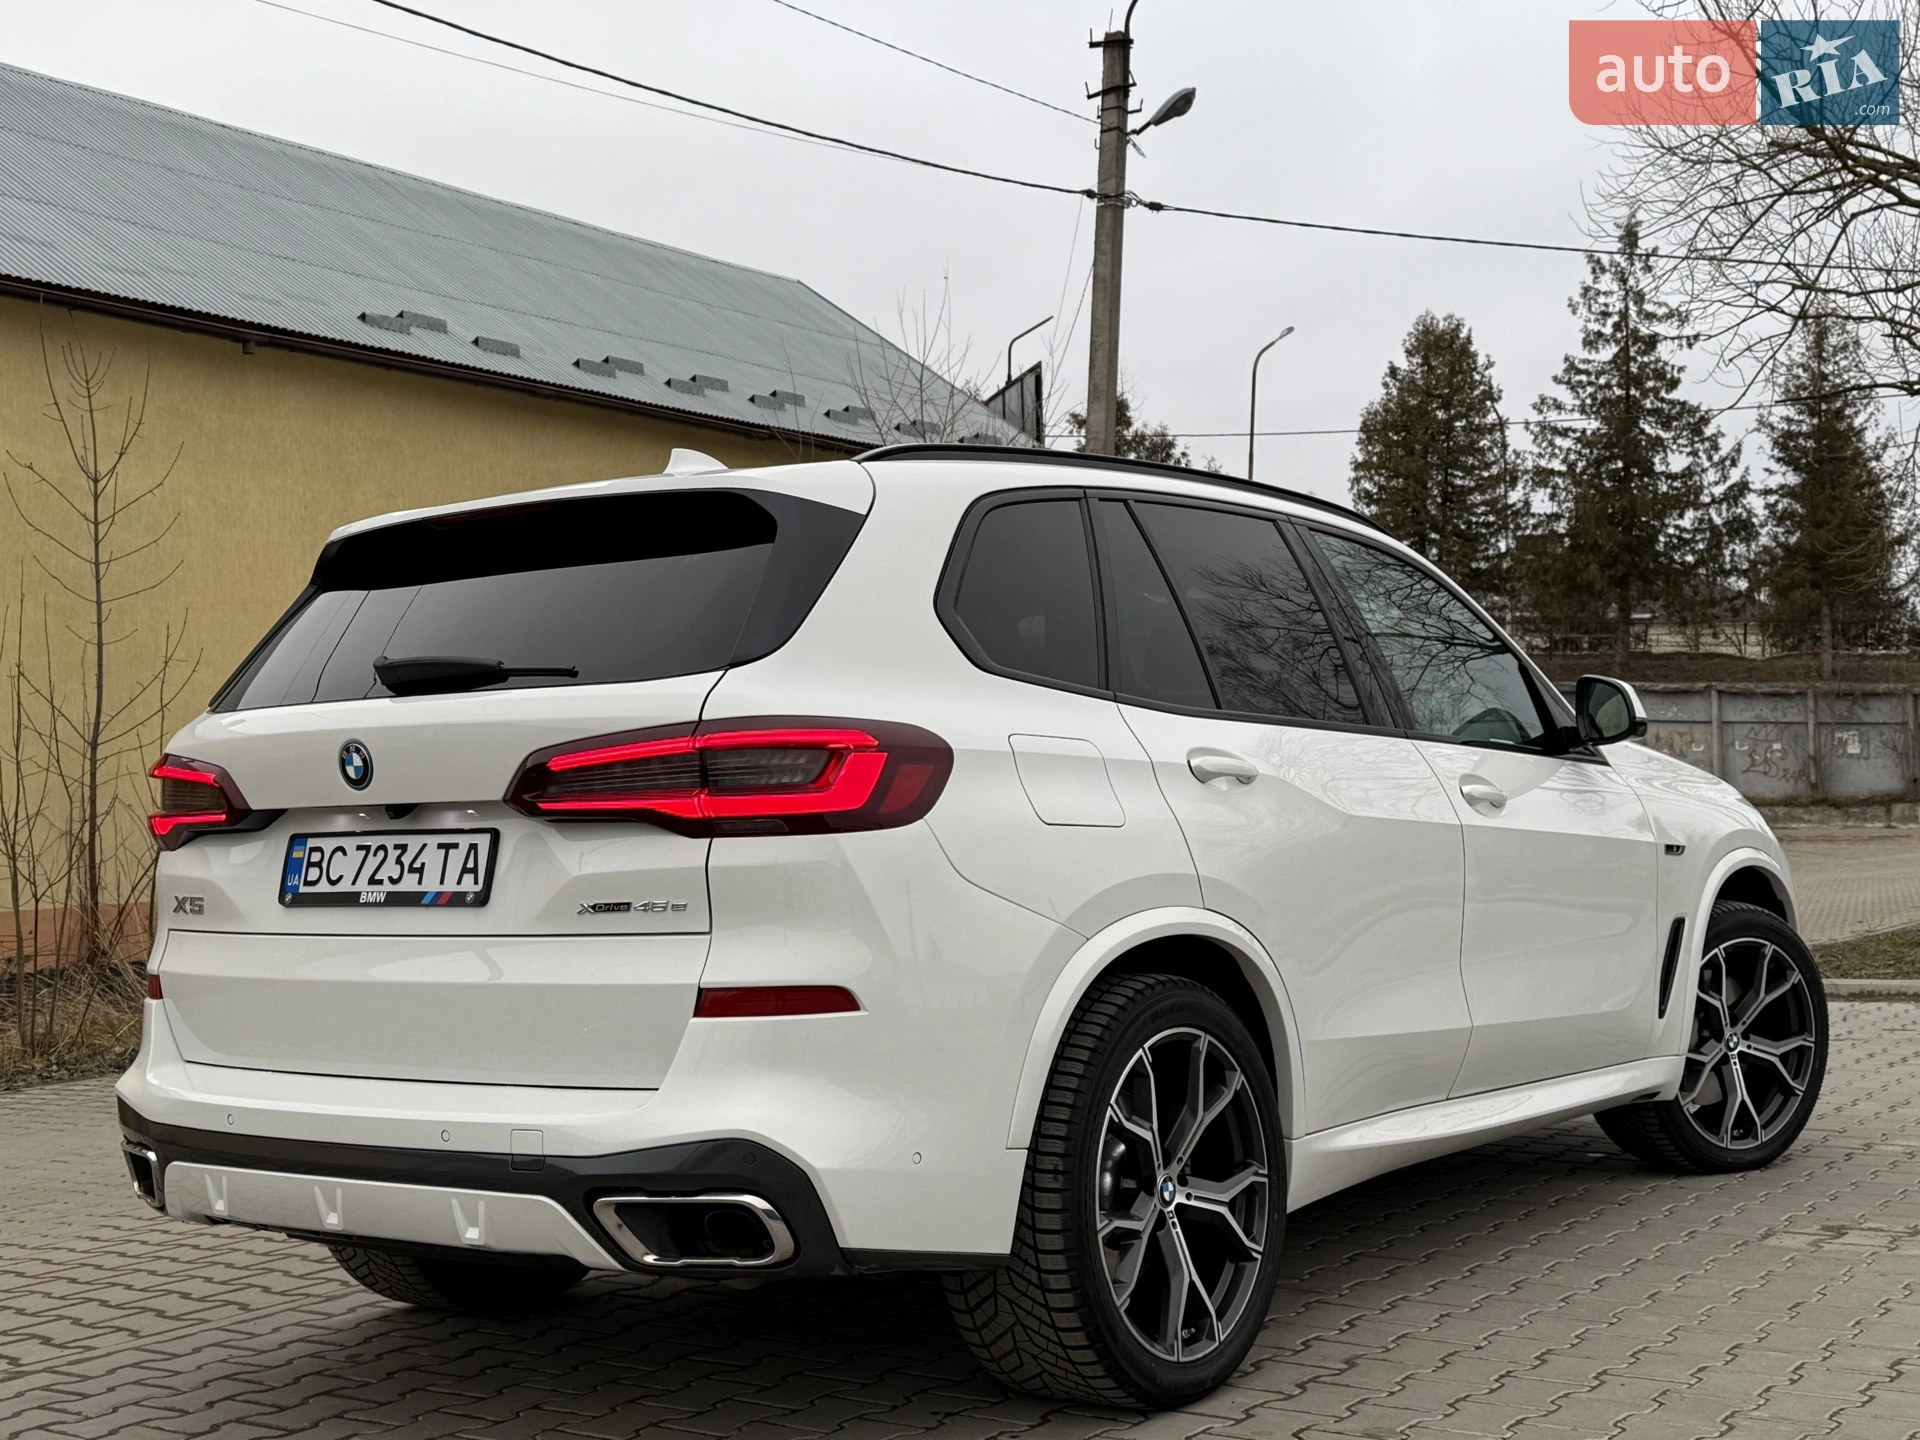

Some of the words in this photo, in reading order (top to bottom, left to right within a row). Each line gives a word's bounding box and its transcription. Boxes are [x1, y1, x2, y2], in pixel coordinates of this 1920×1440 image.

[341, 745, 366, 759] BMW
[287, 873, 299, 886] UA
[359, 891, 387, 903] BMW
[173, 895, 205, 915] X5
